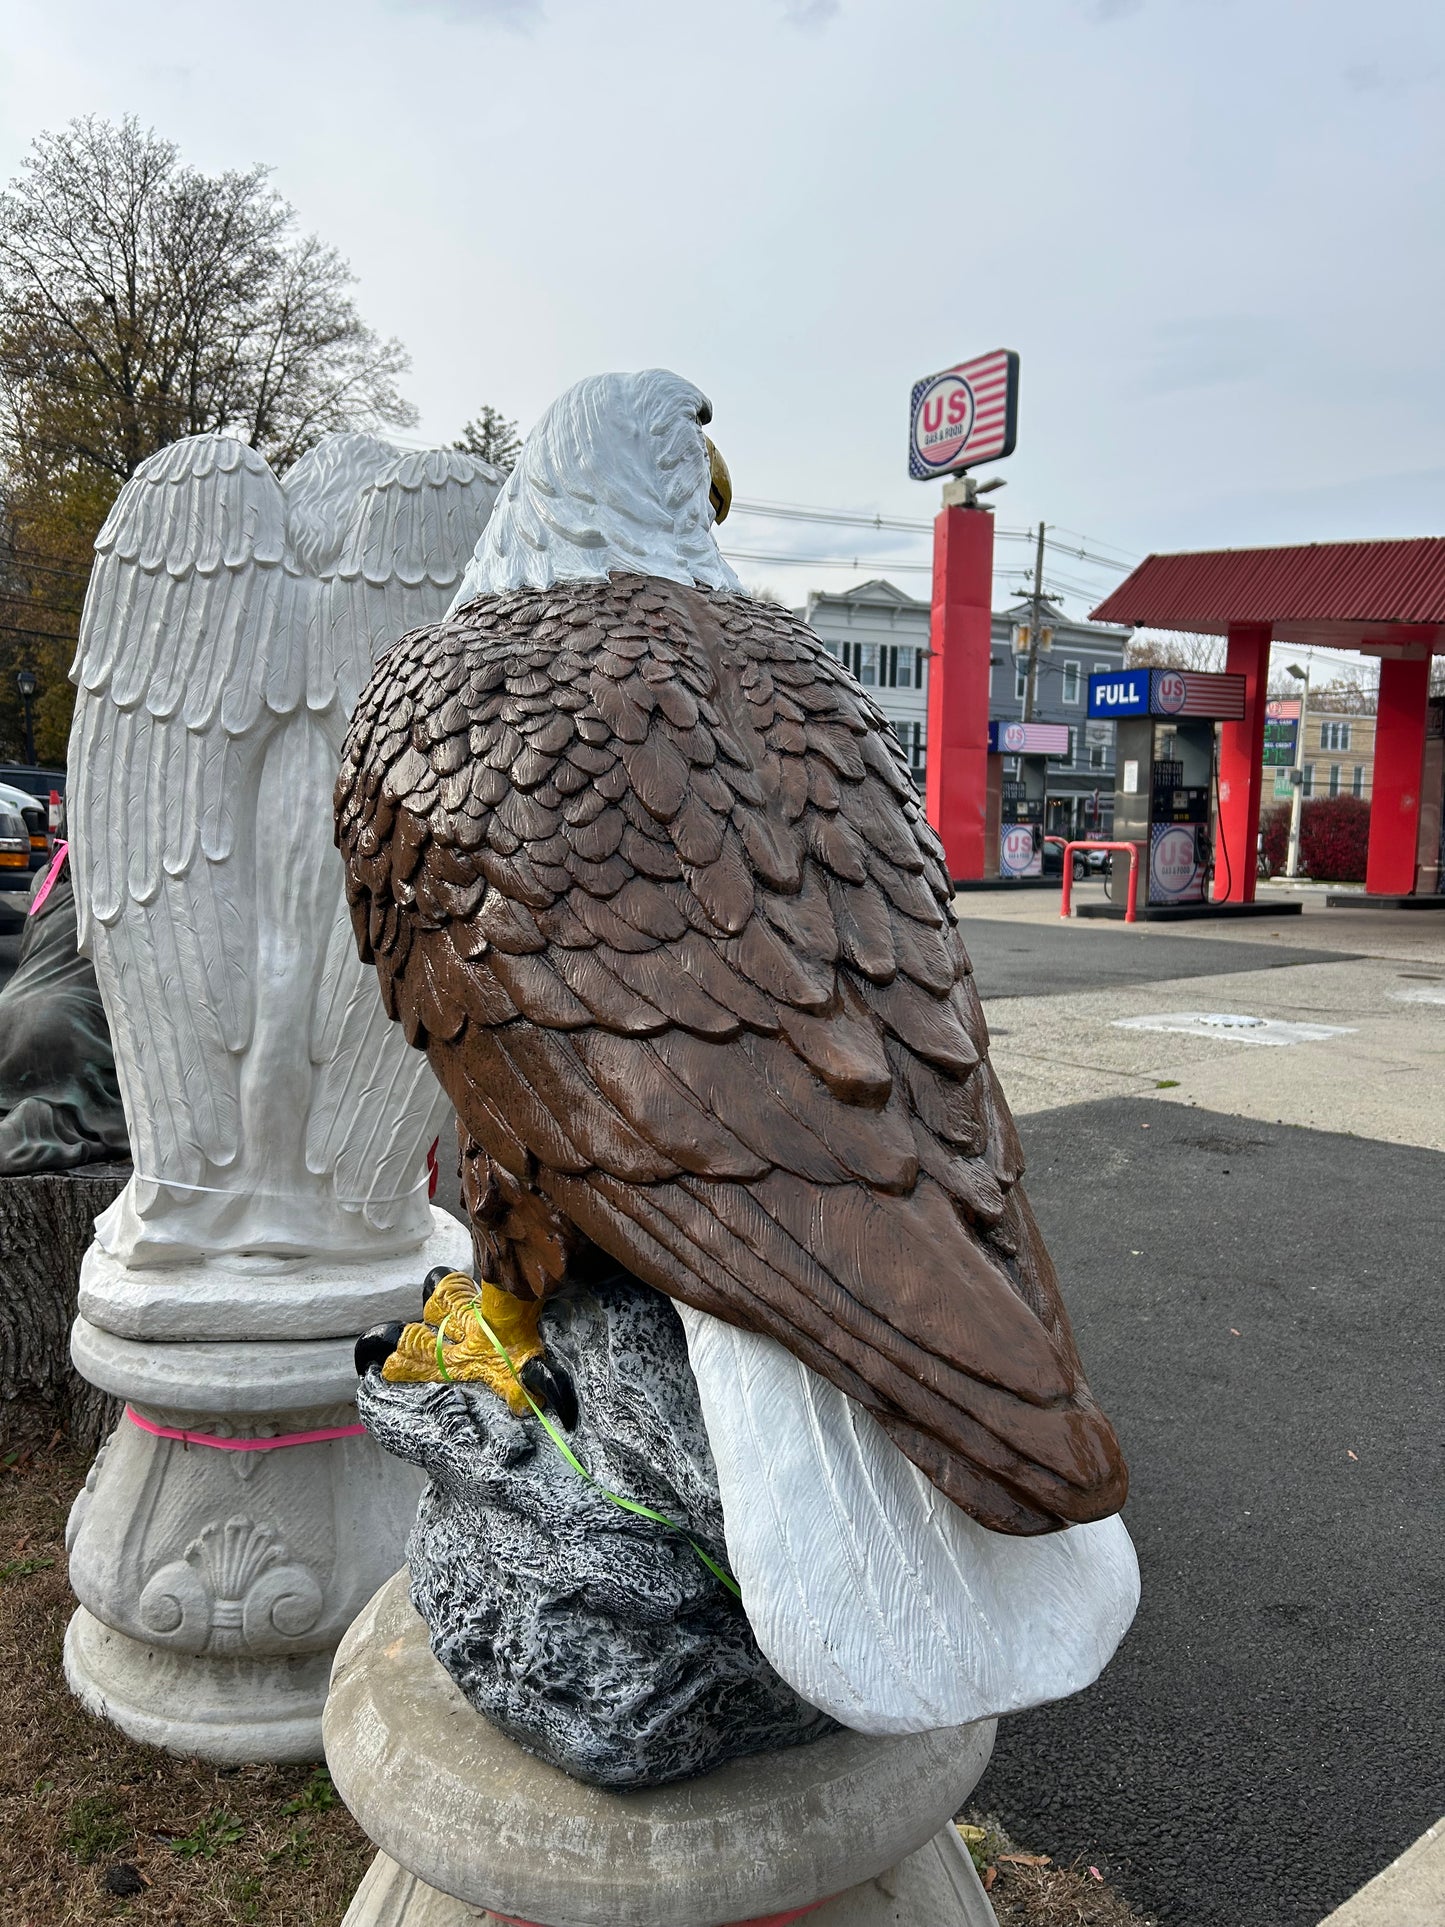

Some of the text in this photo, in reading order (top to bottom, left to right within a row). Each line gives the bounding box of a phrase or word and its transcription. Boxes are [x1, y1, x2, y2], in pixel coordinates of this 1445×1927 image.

[924, 389, 966, 432] US
[944, 424, 963, 437] FOOD
[1095, 682, 1140, 706] FULL
[1161, 679, 1183, 697] US
[1007, 728, 1023, 740] US
[1007, 835, 1032, 853] US
[1160, 840, 1193, 866] US
